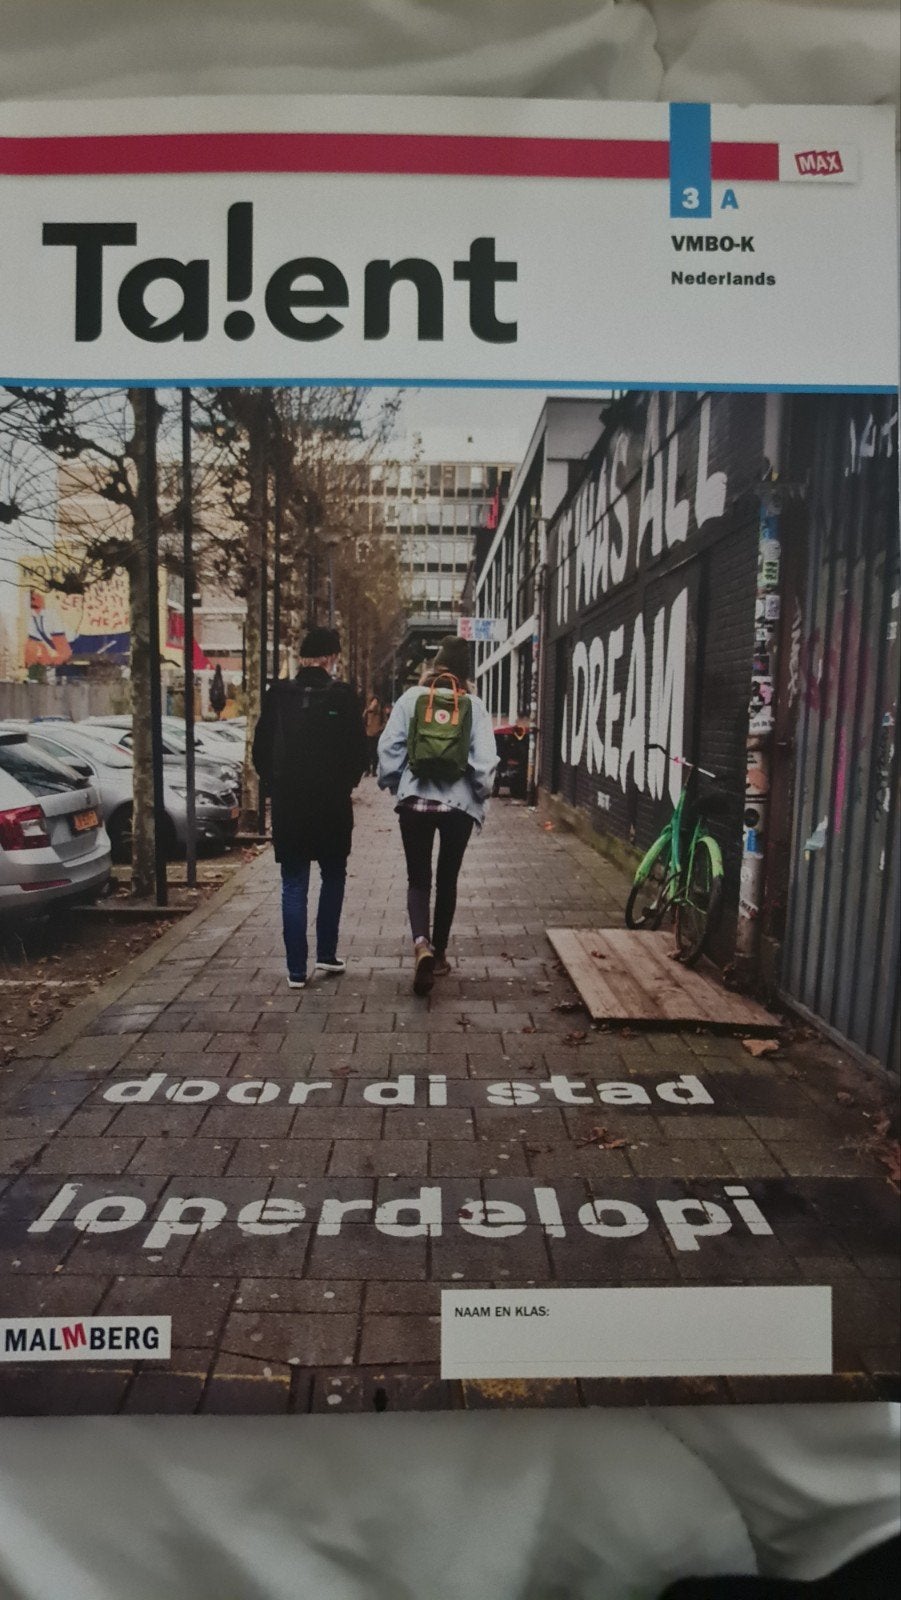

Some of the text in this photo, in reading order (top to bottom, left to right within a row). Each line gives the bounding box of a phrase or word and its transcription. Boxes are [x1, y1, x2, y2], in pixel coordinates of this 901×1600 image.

[798, 152, 841, 174] MAX
[682, 187, 739, 210] 3 A
[671, 235, 755, 252] VMBO-K
[671, 271, 776, 286] Nederlands
[575, 427, 630, 612] WAS
[636, 391, 728, 568] ALL
[570, 587, 688, 811] DREAM
[103, 1073, 714, 1106] door di stad
[27, 1182, 774, 1250] loperdelopi
[454, 1306, 550, 1317] NAAM EN KLAS:
[5, 1322, 160, 1352] MALMBERG
